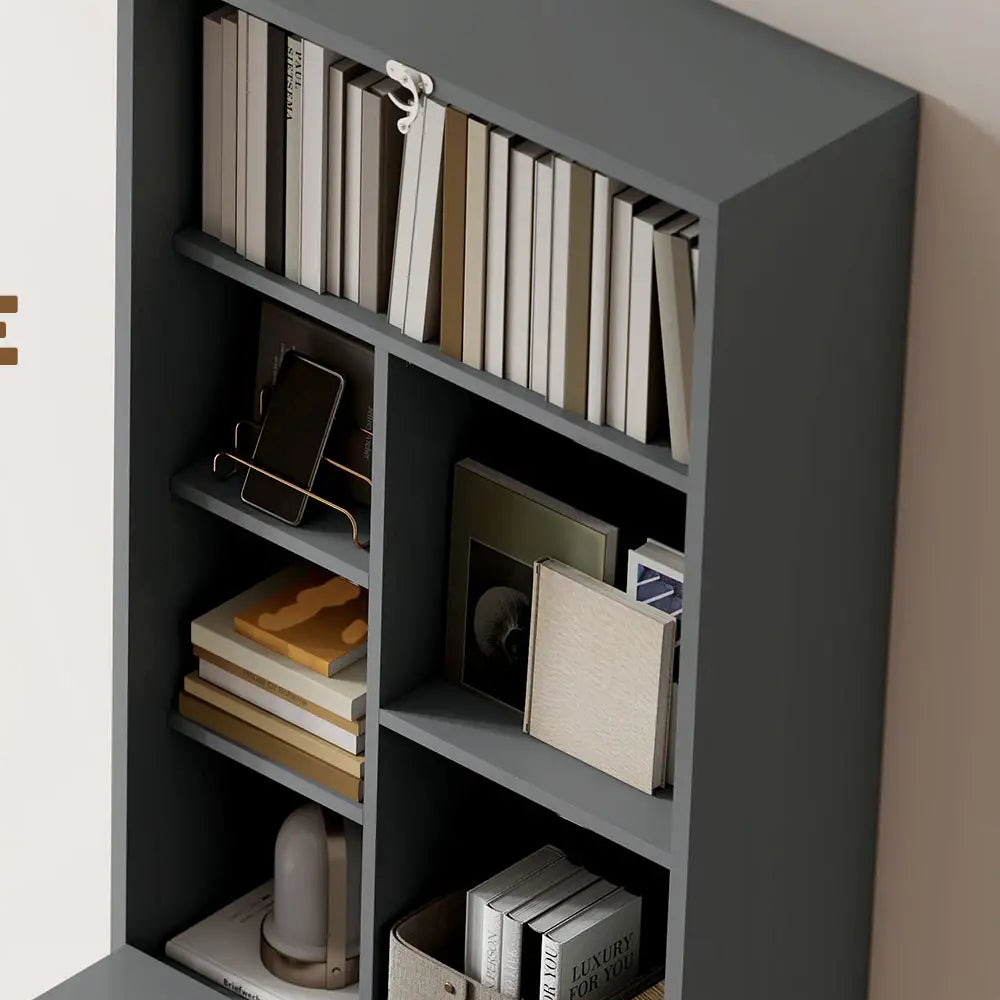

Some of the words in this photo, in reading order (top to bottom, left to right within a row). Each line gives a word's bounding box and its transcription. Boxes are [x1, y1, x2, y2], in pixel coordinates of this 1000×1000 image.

[544, 945, 559, 978] YOU
[571, 932, 635, 983] LUXURY
[602, 951, 634, 982] YOU
